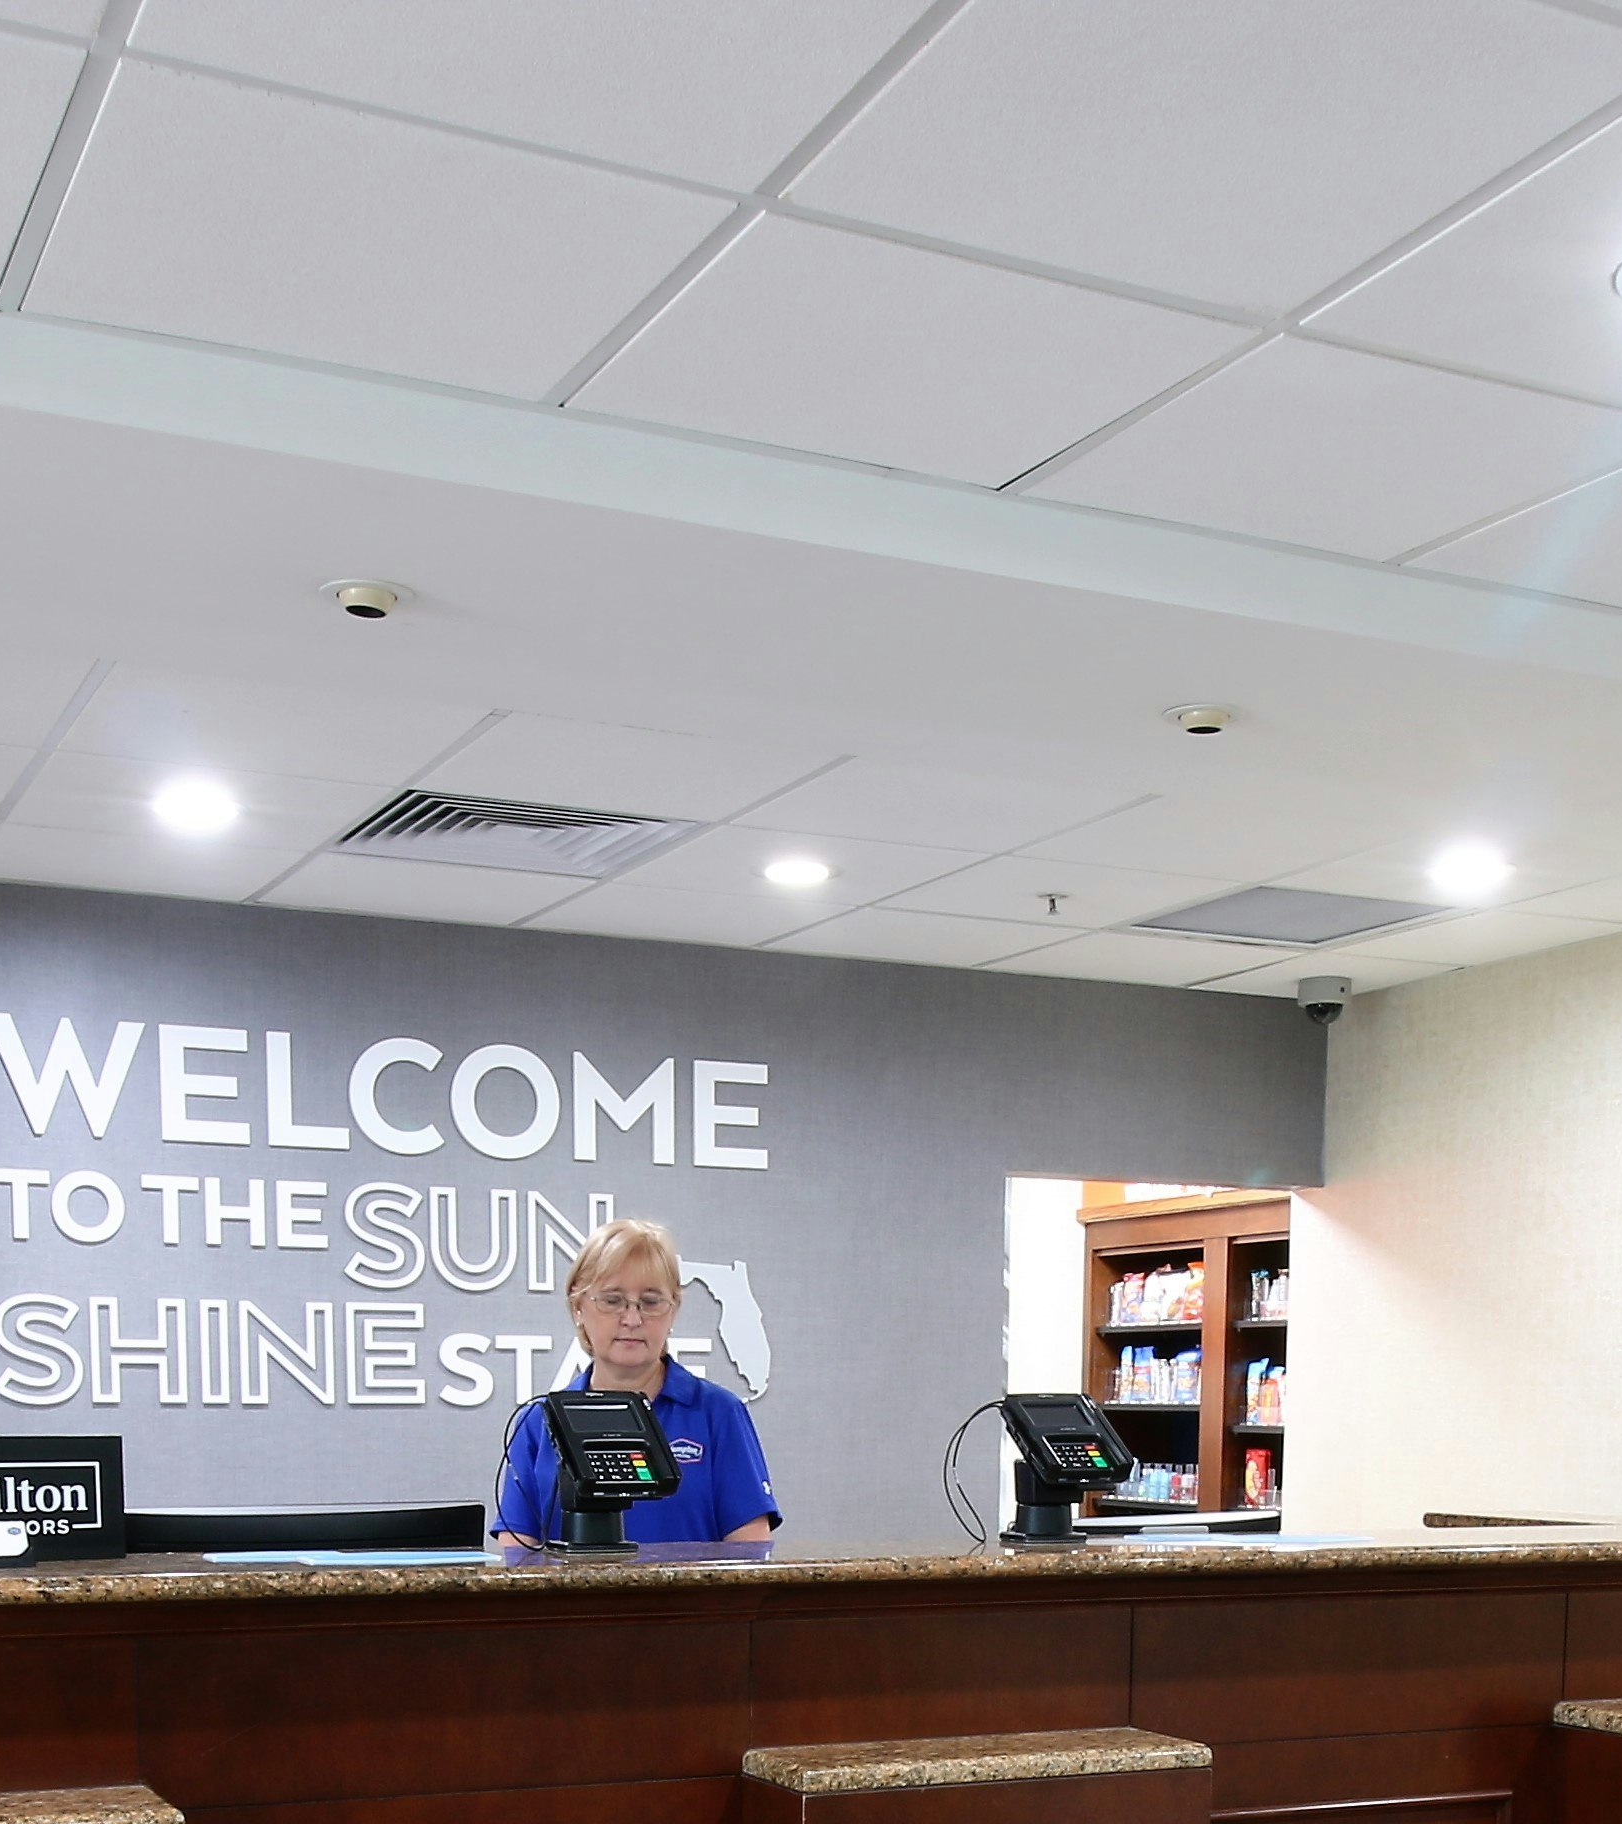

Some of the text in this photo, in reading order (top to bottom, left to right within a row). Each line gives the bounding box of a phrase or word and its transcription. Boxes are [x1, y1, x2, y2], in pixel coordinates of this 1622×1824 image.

[139, 1174, 329, 1249] THE
[343, 1181, 615, 1292] SUN
[438, 1333, 713, 1407] STE
[25, 1519, 70, 1535] ORS
